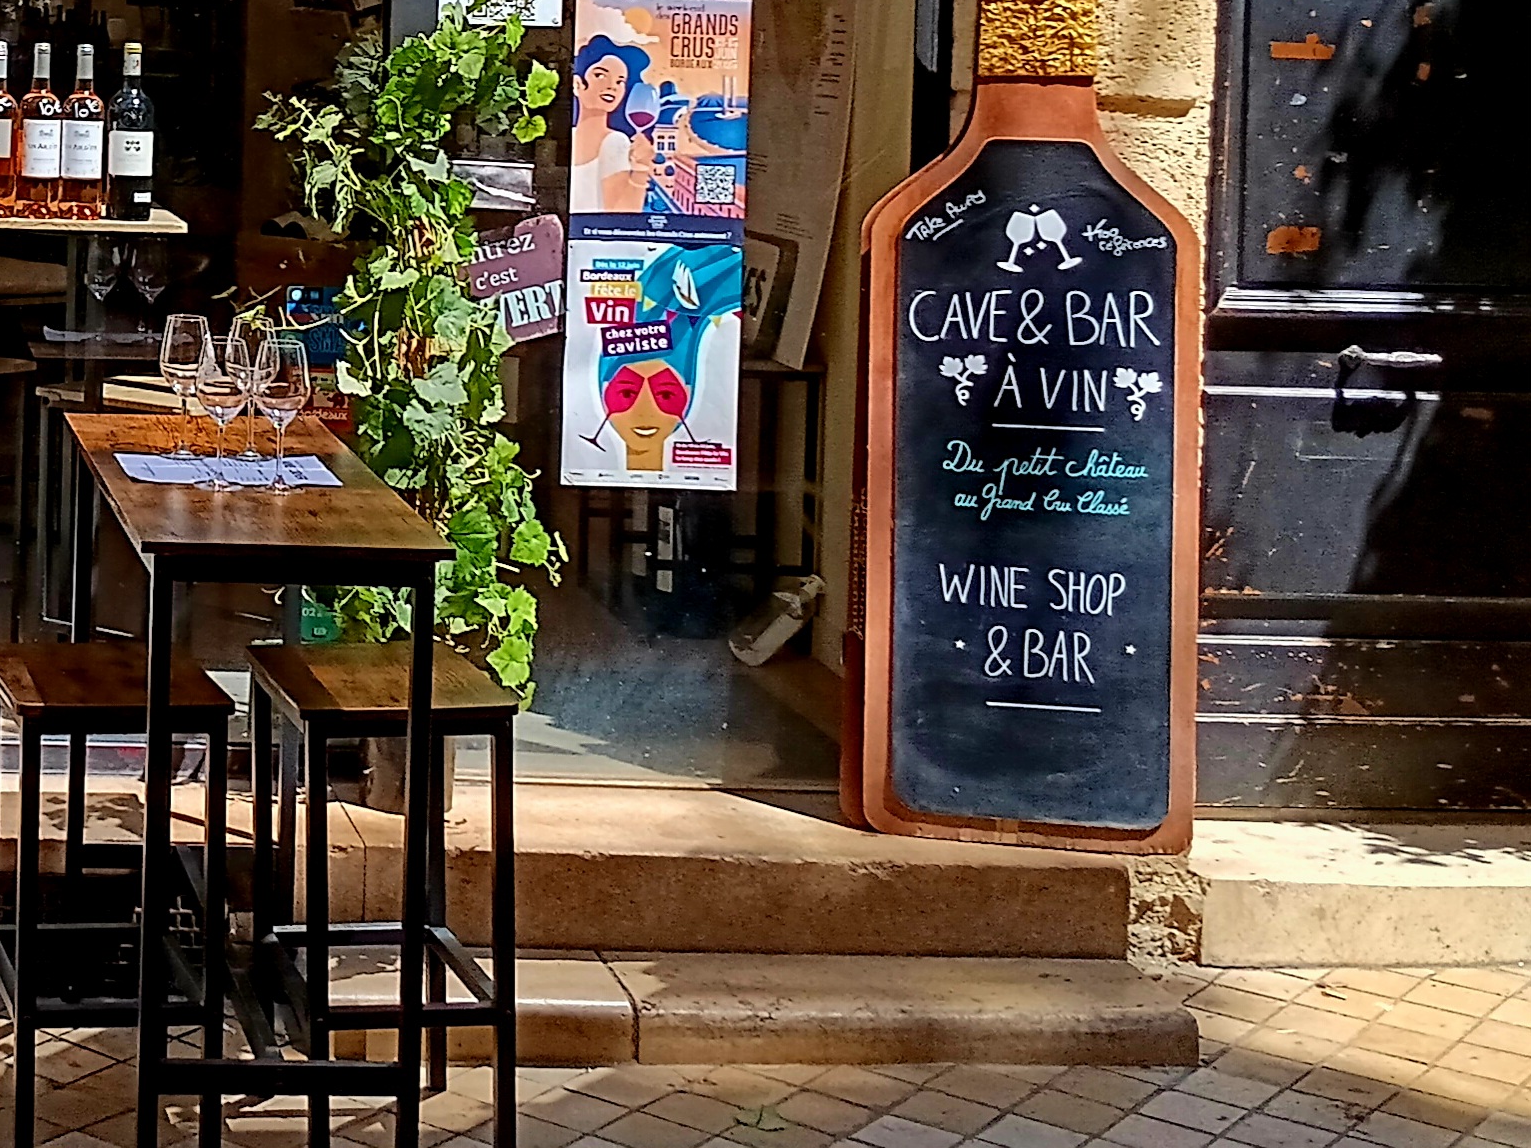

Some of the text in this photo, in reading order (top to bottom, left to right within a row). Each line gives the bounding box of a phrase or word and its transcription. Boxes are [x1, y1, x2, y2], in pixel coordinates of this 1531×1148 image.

[671, 12, 739, 36] GRANDS
[670, 35, 715, 58] CRUS
[670, 58, 713, 69] BORDEAUX
[469, 233, 536, 265] ntrez
[475, 267, 519, 290] c'est
[582, 270, 632, 282] Bordeaux
[624, 283, 637, 296] le
[590, 299, 630, 323] Vin
[908, 288, 1160, 347] CAVE & BAR
[606, 324, 666, 340] chez votre
[607, 337, 668, 354] caviste
[993, 353, 1107, 412] À VIN
[942, 440, 1149, 495] Du petit château
[954, 493, 979, 508] au
[1076, 490, 1130, 516] Classé
[939, 564, 1126, 616] WINE SHOP
[984, 625, 1095, 684] & BAR
